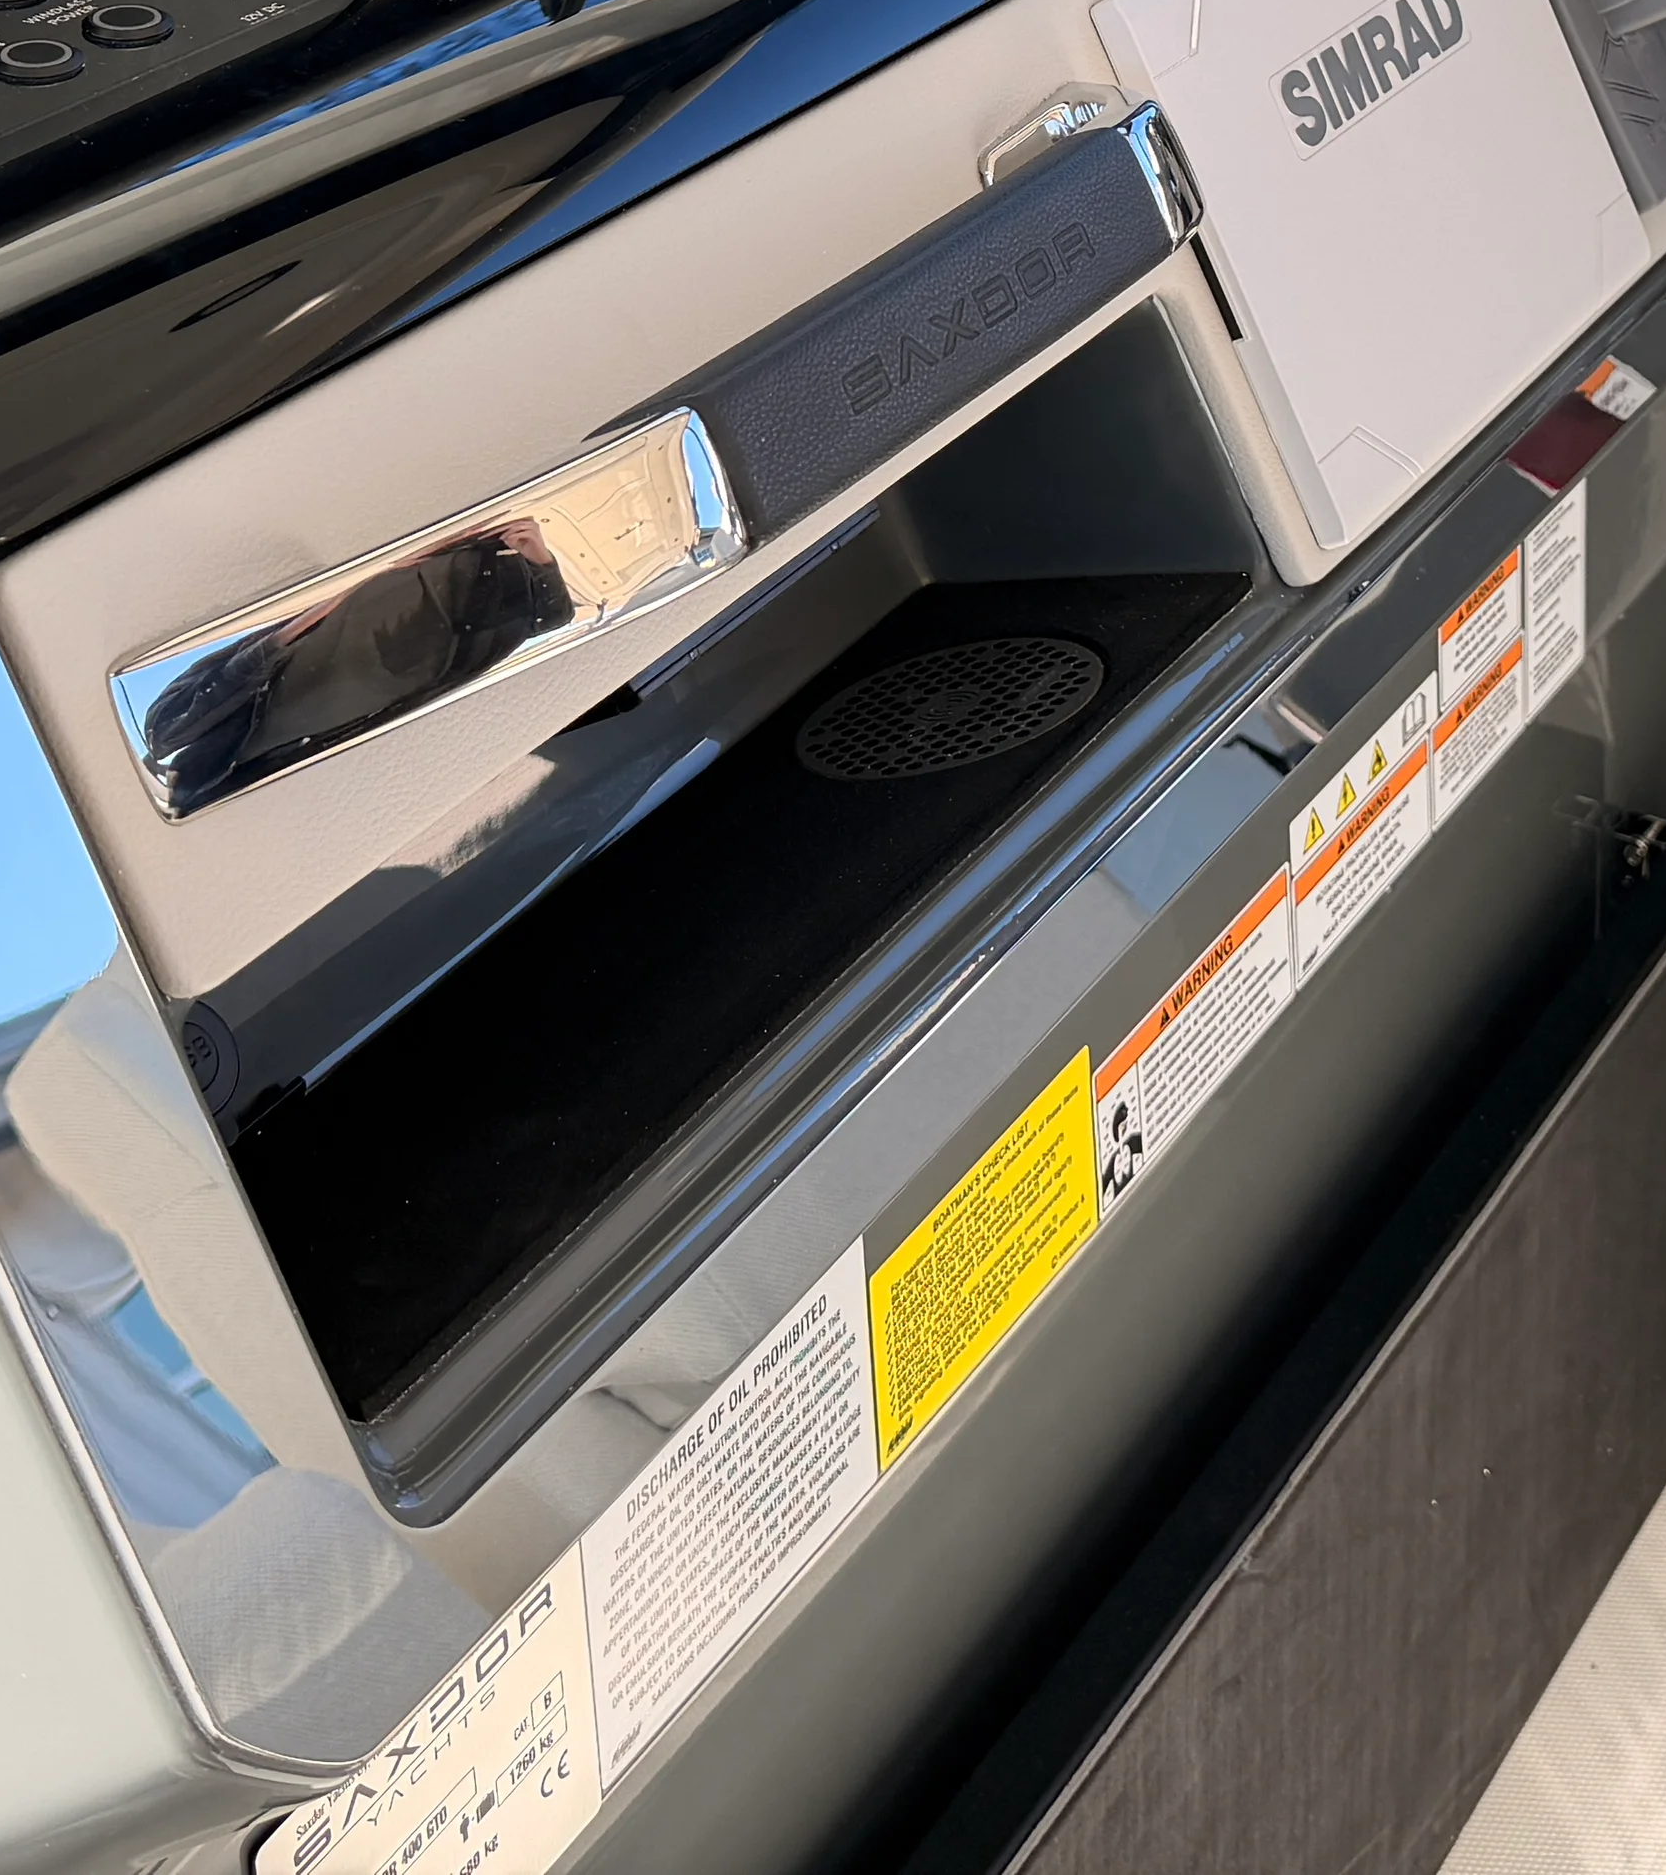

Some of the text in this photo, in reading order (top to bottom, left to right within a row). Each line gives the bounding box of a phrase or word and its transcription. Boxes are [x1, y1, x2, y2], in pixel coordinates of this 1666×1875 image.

[47, 5, 99, 25] POWER
[840, 221, 1099, 416] SAXDOR
[1465, 561, 1504, 617] WARNING
[1464, 659, 1501, 715] WARNING
[1346, 782, 1389, 845] WARNING
[1172, 931, 1232, 1015] WARNING
[932, 1117, 1029, 1234] BOATMAN'S CHECK LIST
[614, 1307, 841, 1564] THE FEDERAL WATER POLLUTION CONTROL ACT PROHIBITS THE
[626, 1291, 826, 1524] DISCHARGE OF OIL PROHIBITED
[602, 1330, 855, 1618] WATERS OF THE UNITED STATES, OR THE WATERS OF THE CONTIGUOUS
[609, 1320, 847, 1589] DISCHARGE OF OIL OR OILY WASTE INTO OR UPON THE NAVIGABLE
[294, 1582, 552, 1875] SAXDOR
[514, 1691, 552, 1740] CAT. B
[367, 1684, 495, 1826] YACHTS
[509, 1729, 554, 1786] 1260 kg
[540, 1749, 570, 1798] CE
[402, 1806, 448, 1865] 400 GTO
[484, 1832, 500, 1857] kg
